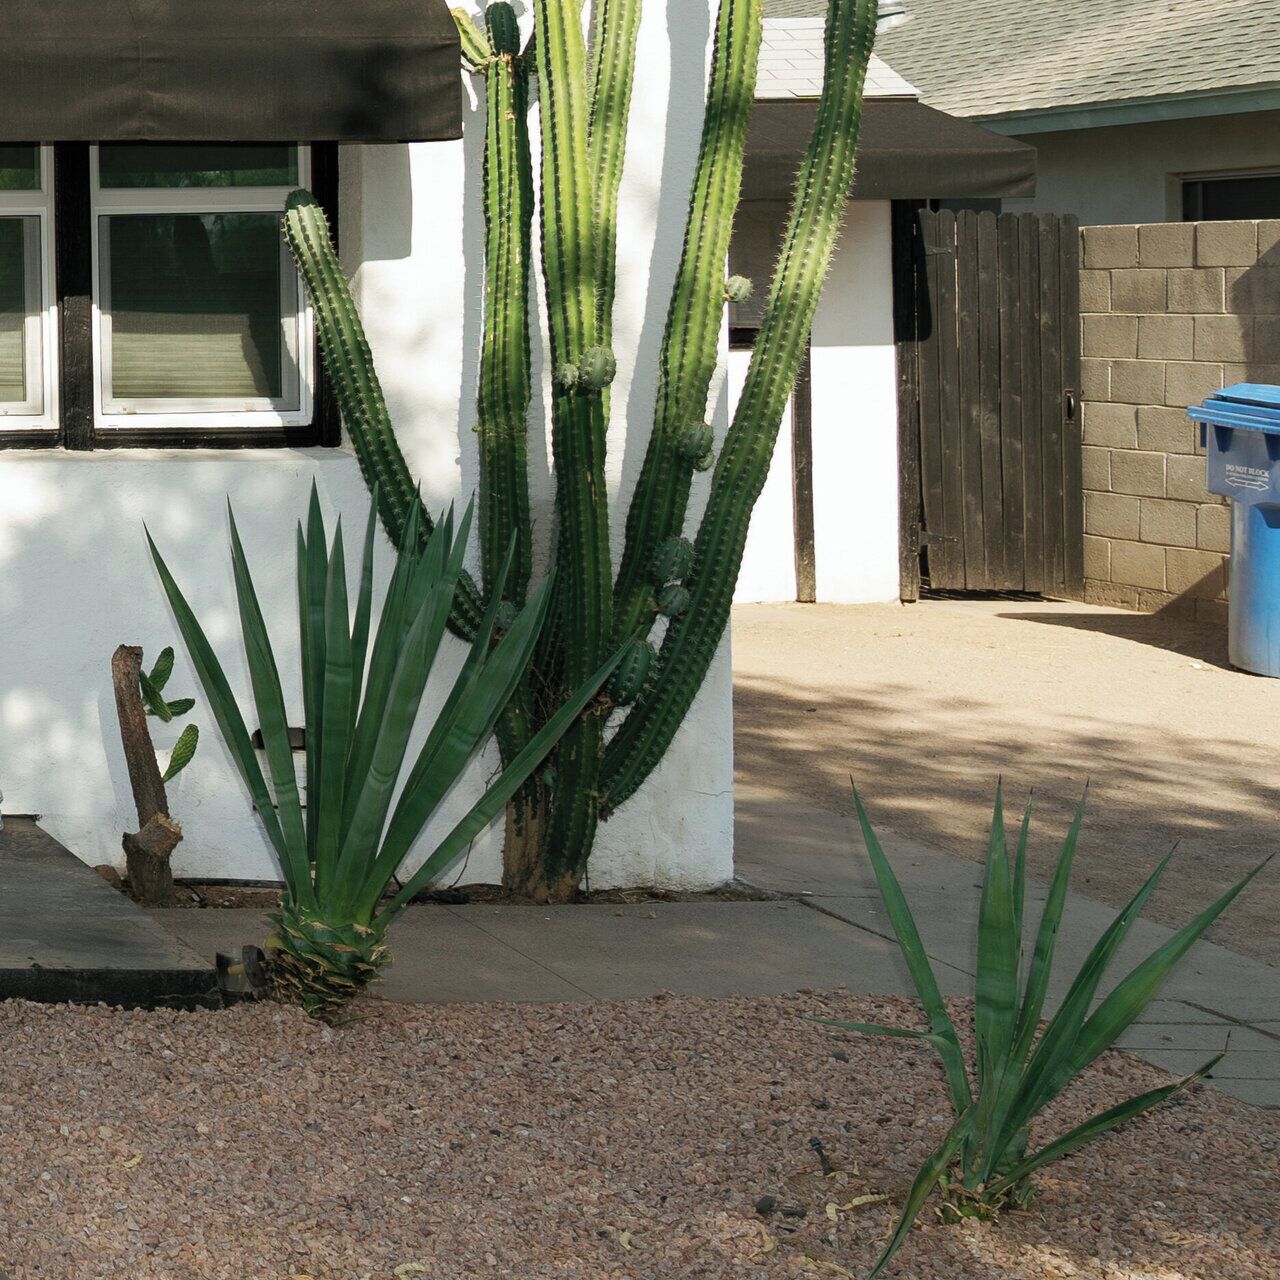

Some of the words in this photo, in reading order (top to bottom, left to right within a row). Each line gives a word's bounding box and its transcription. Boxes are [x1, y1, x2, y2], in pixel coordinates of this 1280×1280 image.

[1225, 464, 1235, 472] DO
[1235, 465, 1248, 473] NOT
[1248, 467, 1270, 478] BLOCK
